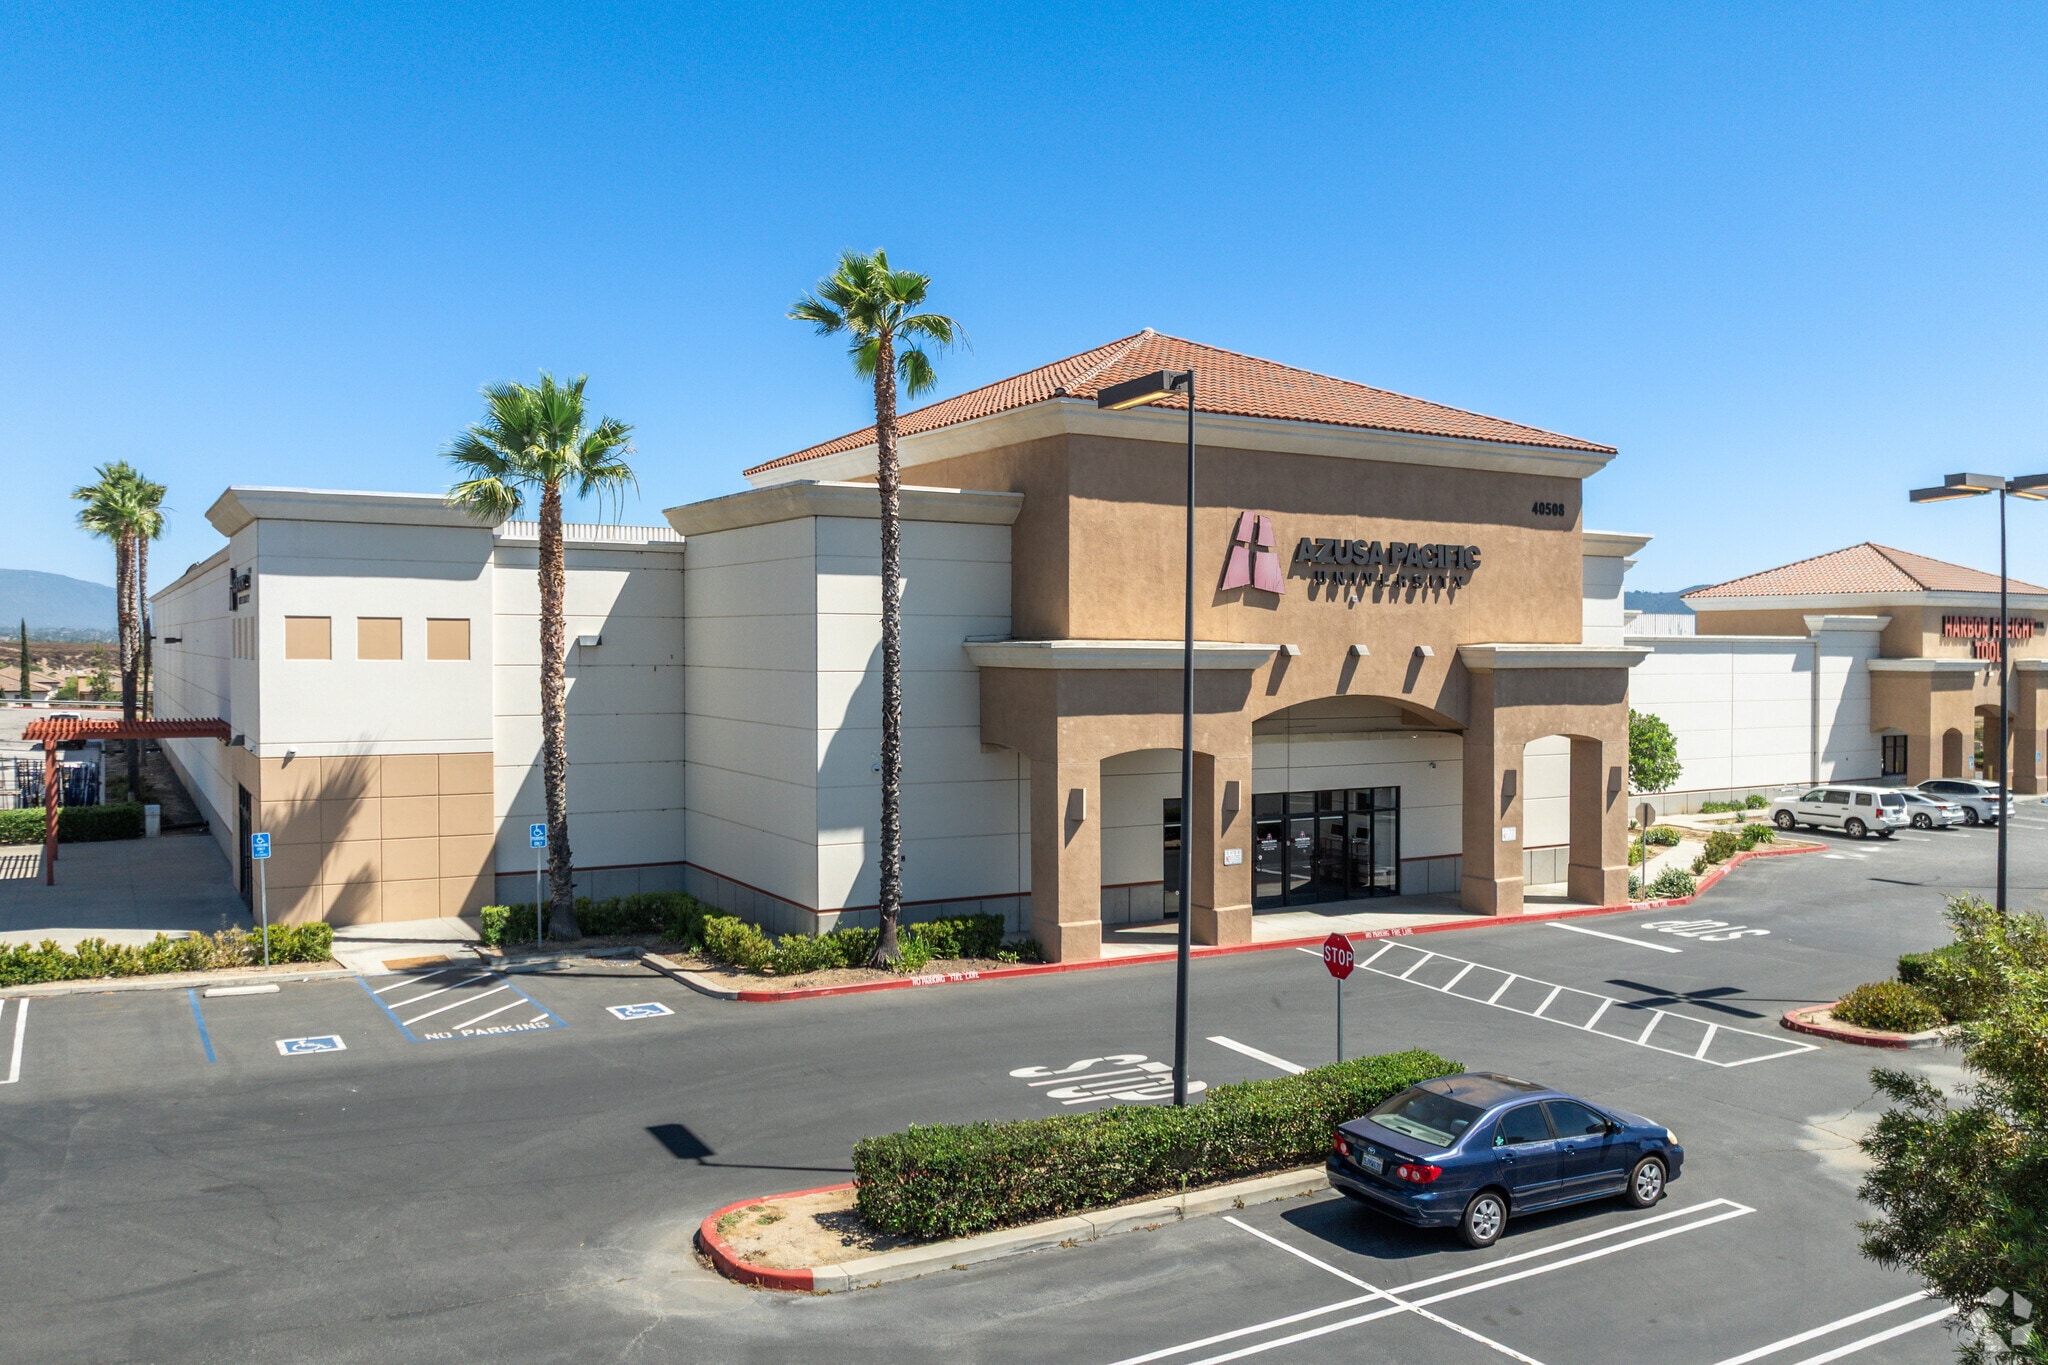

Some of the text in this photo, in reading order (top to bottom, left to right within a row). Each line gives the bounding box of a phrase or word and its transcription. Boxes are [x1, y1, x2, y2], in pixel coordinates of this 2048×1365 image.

[1532, 502, 1565, 517] 40508
[1296, 537, 1482, 570] AZUSA PACIFIC
[1314, 570, 1464, 590] UNIVERSITY
[1942, 615, 1989, 639] HARBOR
[1640, 919, 1771, 941] STOP
[1324, 945, 1353, 968] STOP
[910, 976, 921, 986] NO
[948, 972, 964, 982] FIRE
[424, 1021, 550, 1040] NO PARKING
[1008, 1054, 1208, 1106] STOP
